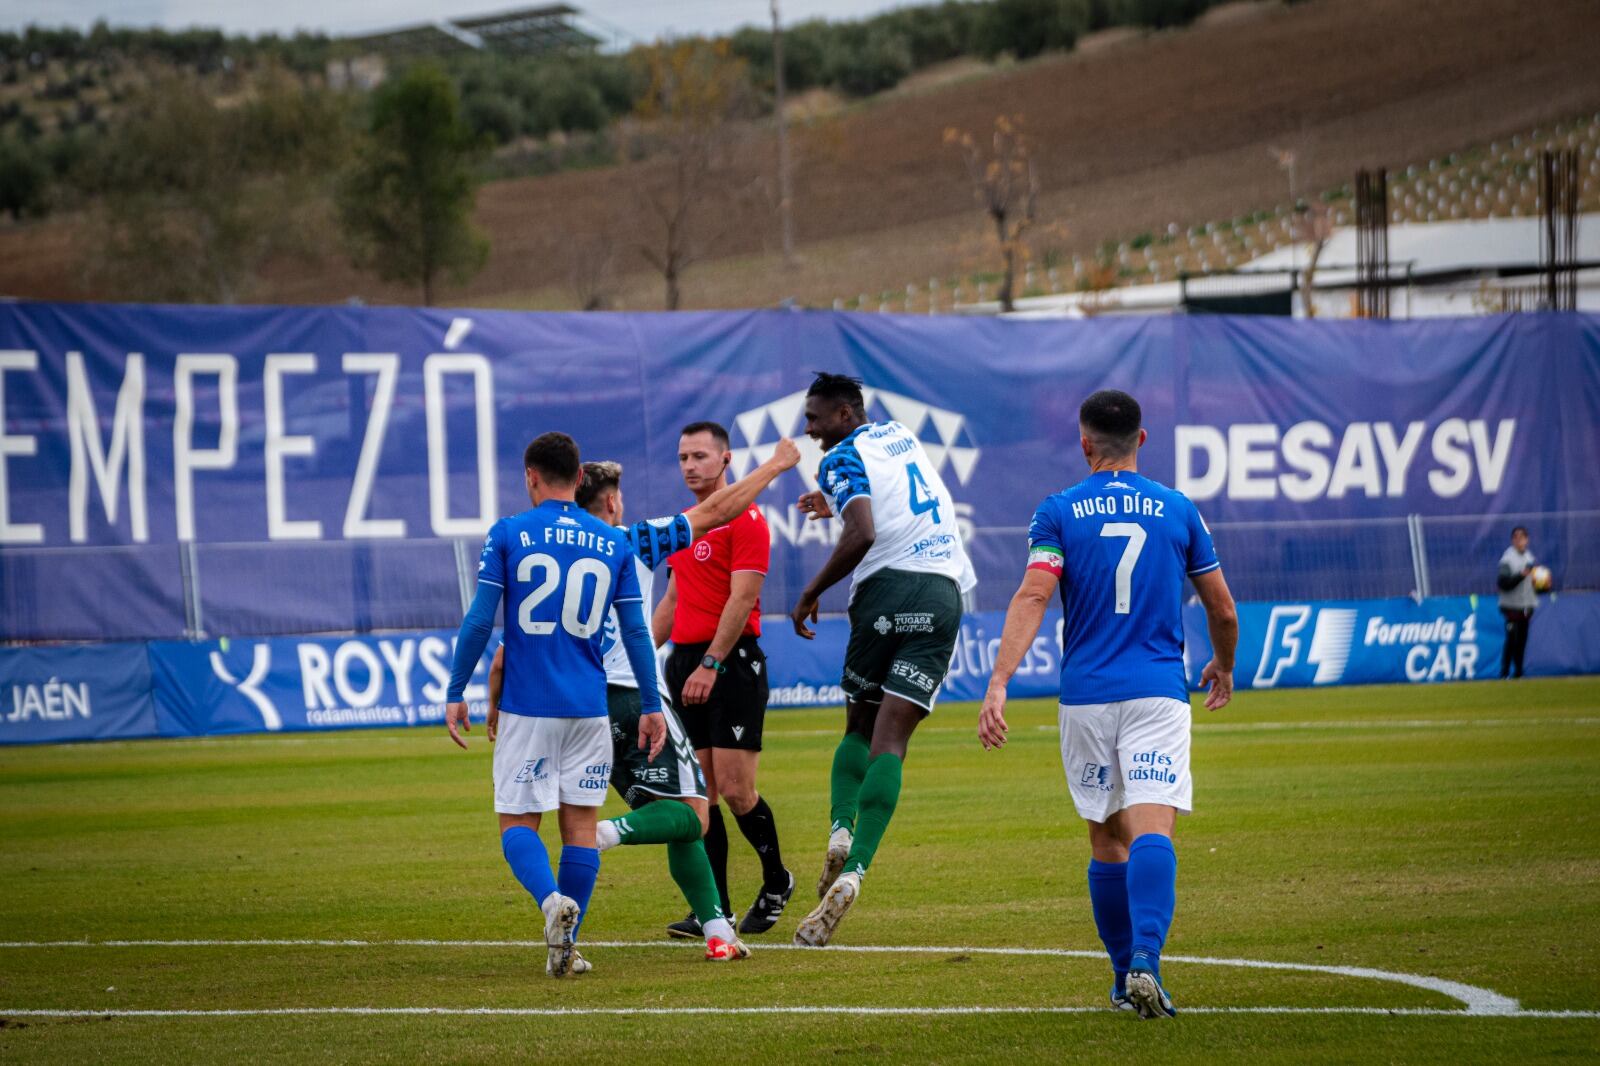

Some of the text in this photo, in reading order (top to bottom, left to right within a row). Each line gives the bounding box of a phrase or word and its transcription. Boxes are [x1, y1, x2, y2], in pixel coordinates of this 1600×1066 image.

[883, 437, 917, 457] UDOM
[1174, 417, 1516, 501] DESAY SV
[905, 461, 940, 524] 4
[1072, 491, 1164, 519] HUGO DÍAZ
[519, 527, 616, 556] A. FUENTES
[1100, 523, 1147, 614] 7
[517, 552, 611, 639] 20
[895, 616, 931, 625] TUGASA
[1364, 613, 1477, 646] Formula 1
[891, 663, 934, 690] REYES
[1405, 643, 1479, 683] CAR
[7, 676, 91, 722] JAÉN
[306, 704, 400, 724] rodamientos
[1133, 751, 1172, 766] cafés
[1128, 766, 1176, 784] cástulo
